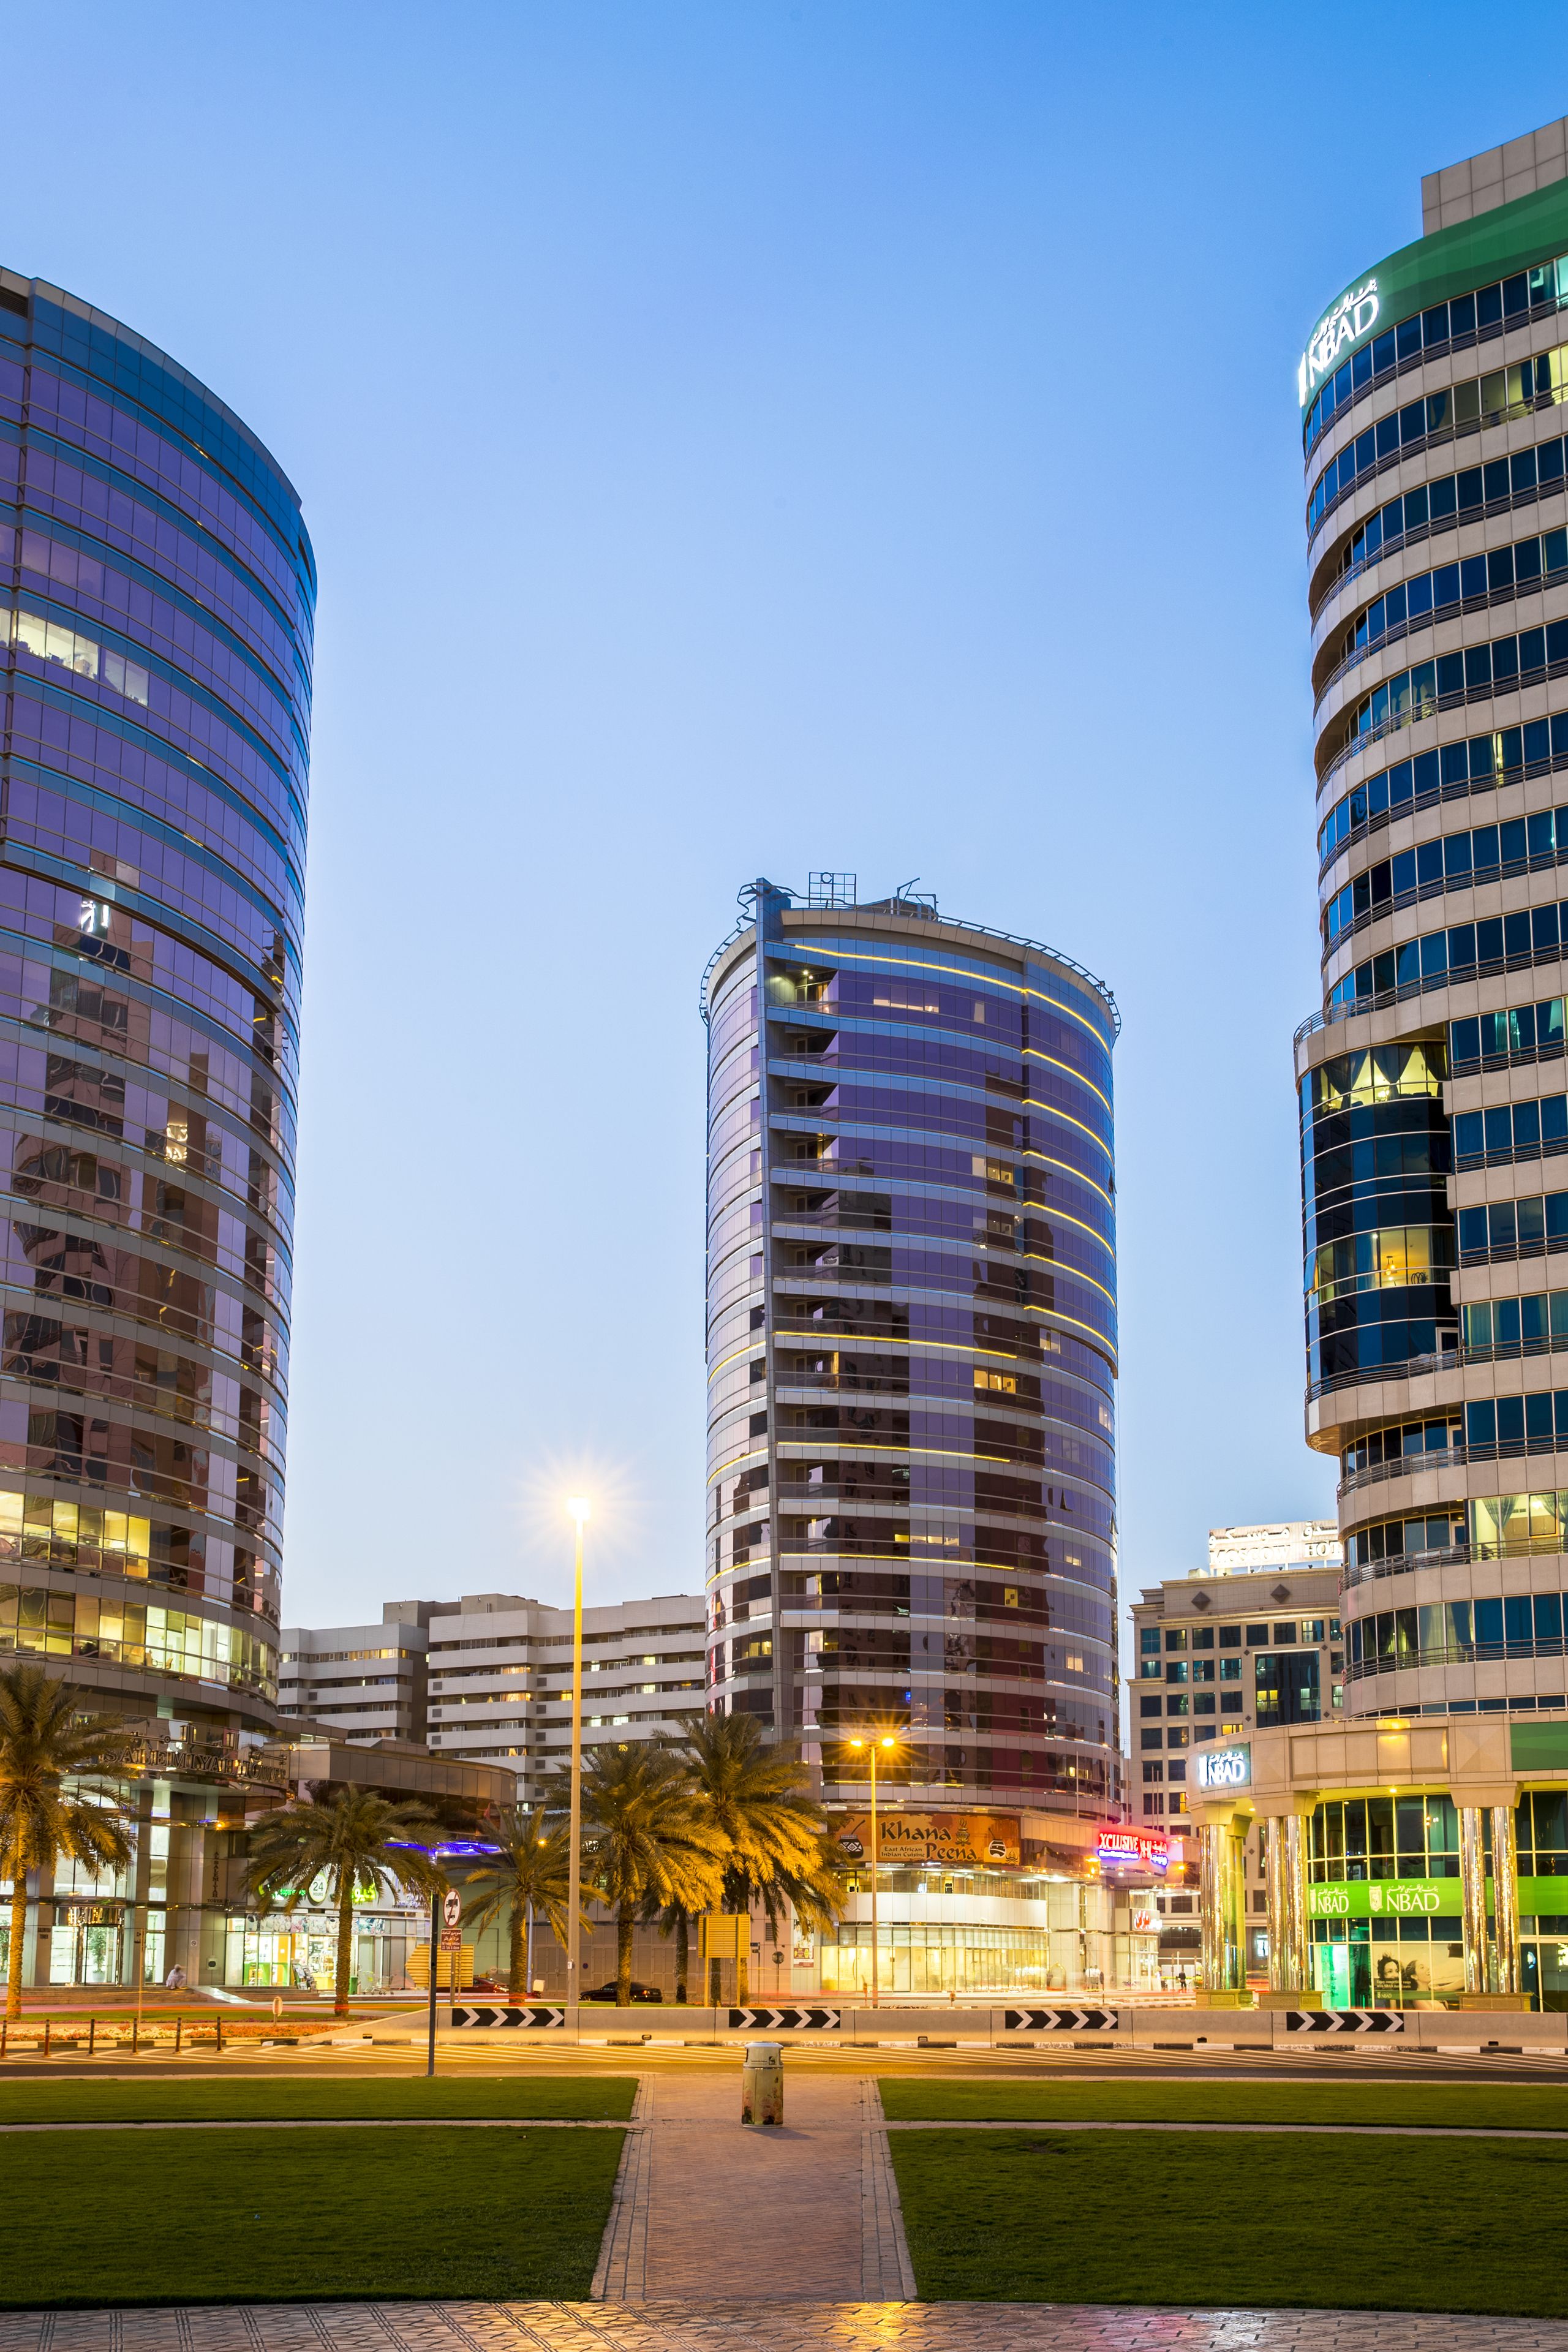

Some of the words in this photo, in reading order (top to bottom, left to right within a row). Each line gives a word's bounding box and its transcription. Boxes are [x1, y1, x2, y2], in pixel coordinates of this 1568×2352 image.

[1309, 294, 1379, 388] NBAD
[1209, 1527, 1290, 1549] موسكو
[1302, 1521, 1338, 1540] دق
[1209, 1545, 1291, 1563] MOSCOW
[1305, 1541, 1343, 1558] HOT
[105, 1745, 236, 1776] SALEMIYAH
[241, 1759, 287, 1783] TOWER
[1208, 1760, 1245, 1785] NBAD
[880, 1819, 952, 1841] Khana
[925, 1842, 978, 1861] Peena
[1099, 1833, 1139, 1851] XCLUSIVE
[313, 1882, 323, 1891] 24
[1318, 1896, 1349, 1914] NBAD
[1387, 1893, 1440, 1912] NBAD
